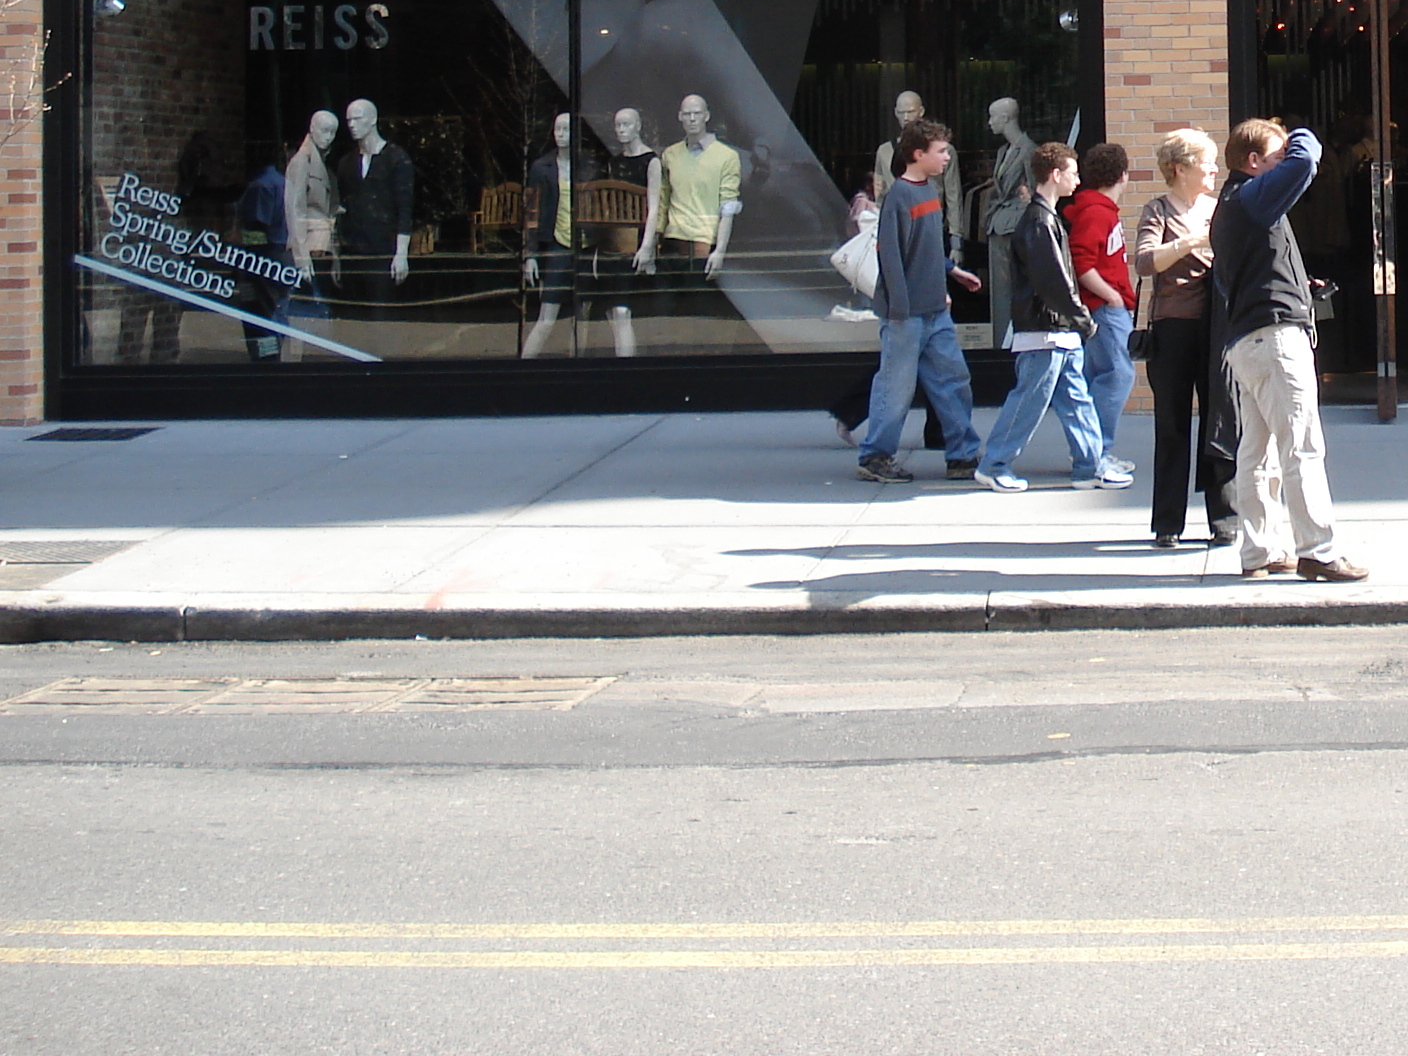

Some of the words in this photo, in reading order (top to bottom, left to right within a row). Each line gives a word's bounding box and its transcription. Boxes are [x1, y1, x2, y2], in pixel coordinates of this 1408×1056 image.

[250, 3, 390, 51] REISS
[118, 172, 182, 216] Reiss
[101, 232, 236, 299] Collections
[109, 201, 306, 289] Spring/Summer
